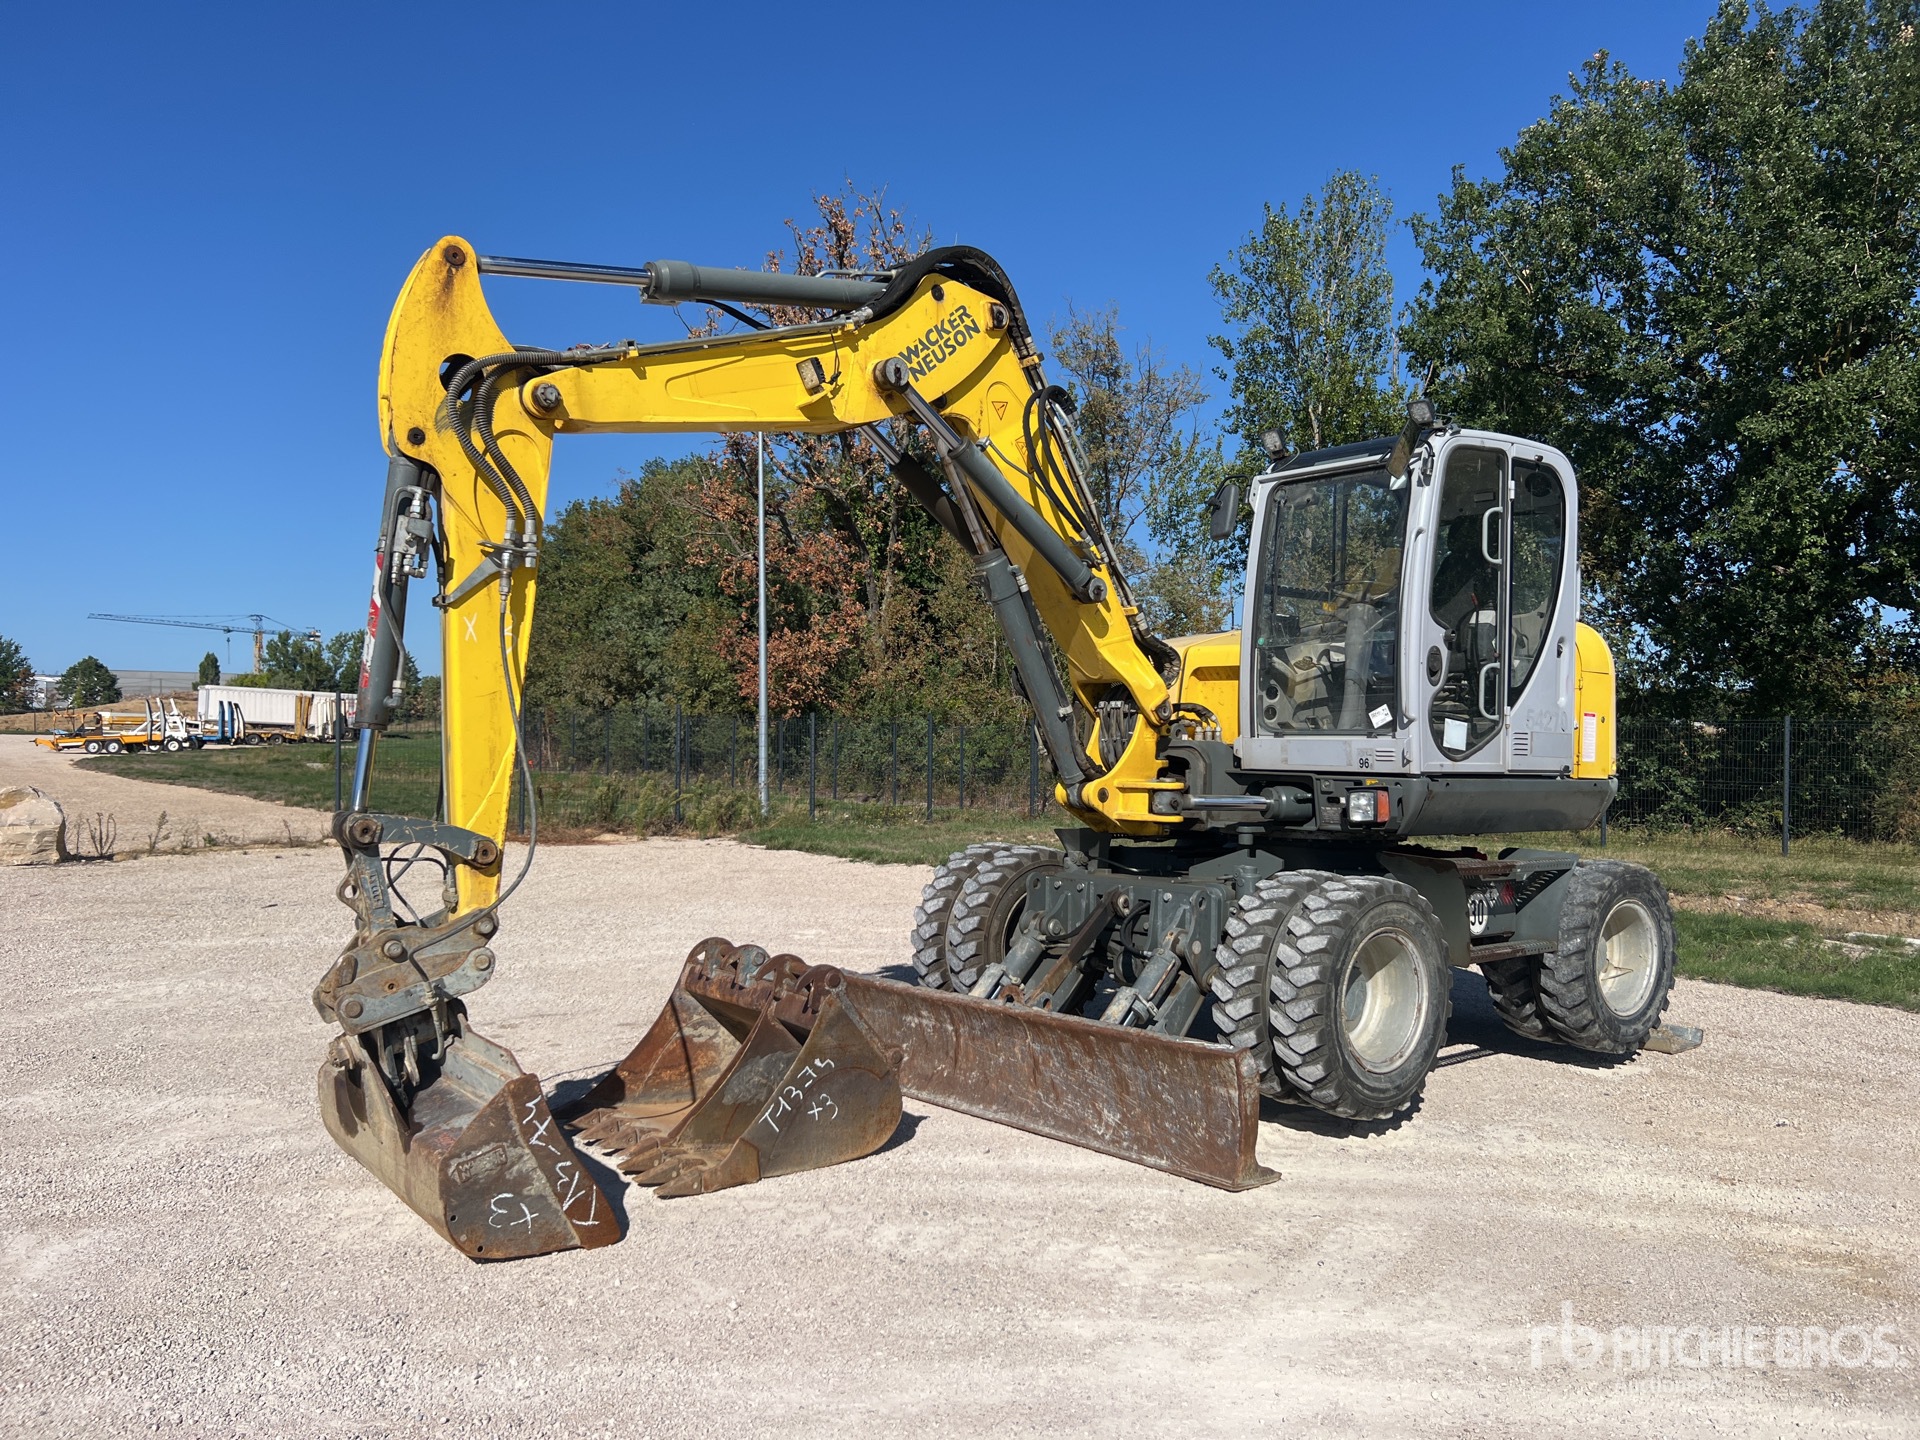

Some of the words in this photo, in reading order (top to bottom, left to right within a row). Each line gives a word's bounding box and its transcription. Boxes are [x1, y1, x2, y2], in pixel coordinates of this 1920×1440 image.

[898, 305, 973, 365] WACKER
[909, 319, 981, 383] NEUSON
[1358, 757, 1370, 769] 96
[1470, 899, 1484, 926] 30
